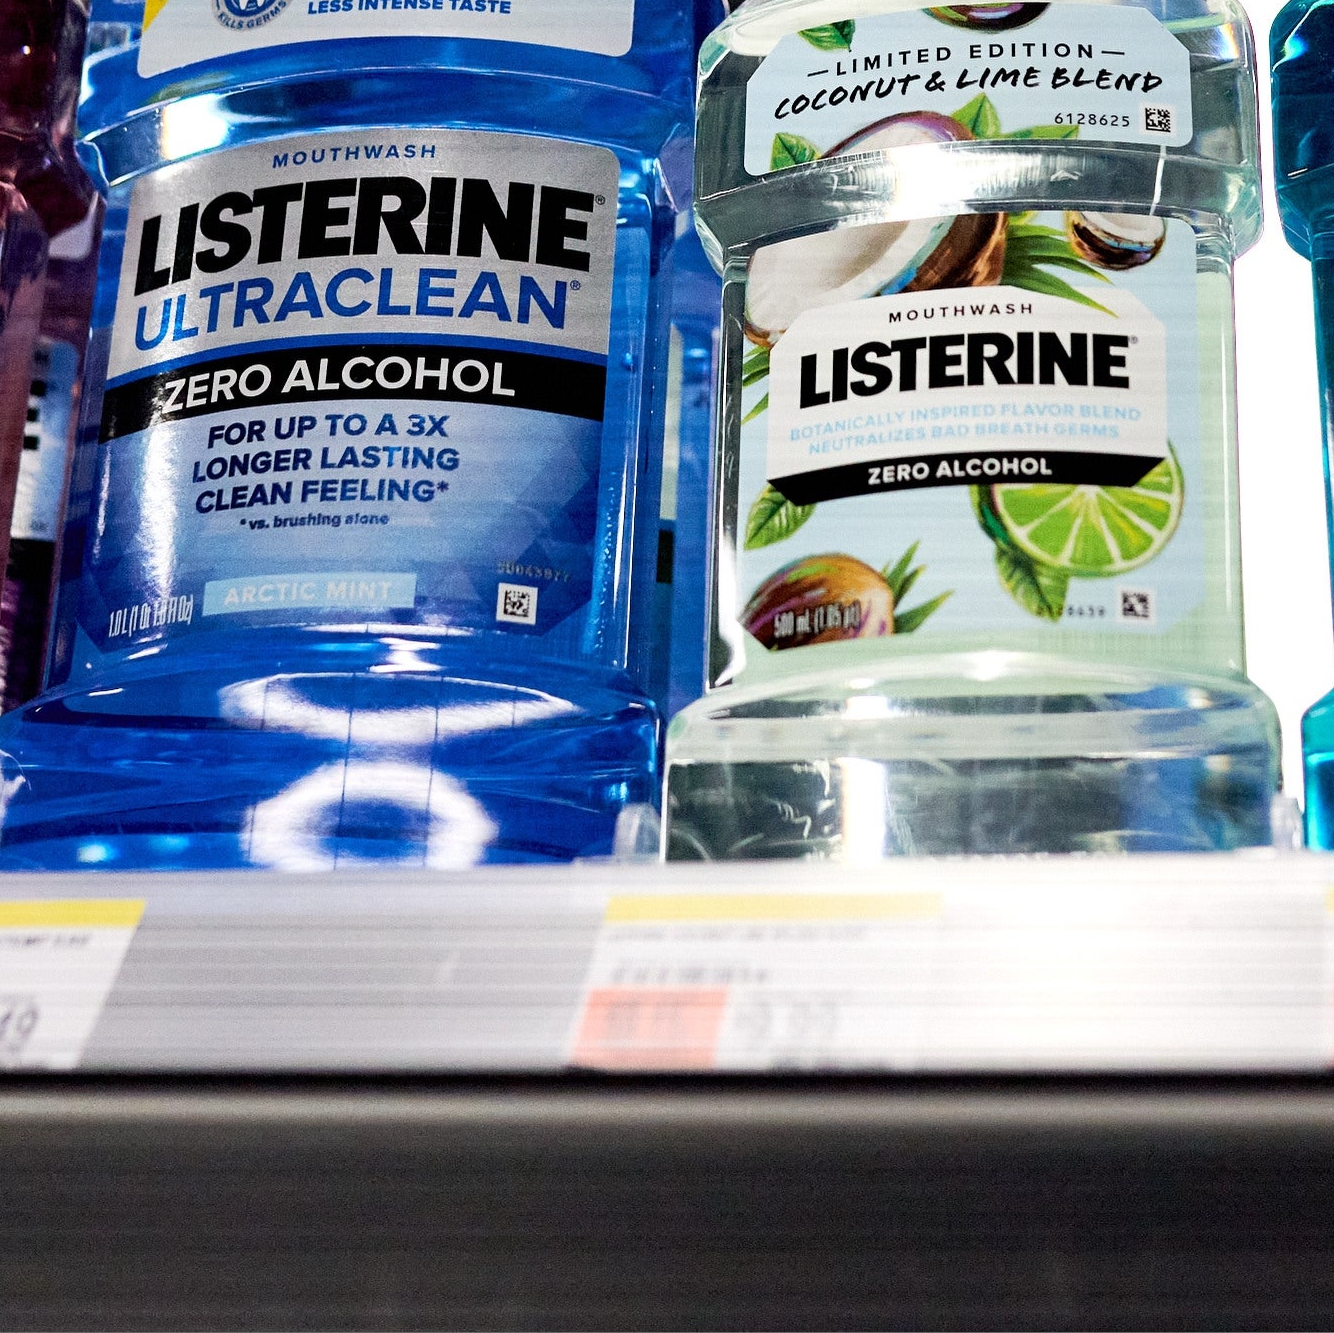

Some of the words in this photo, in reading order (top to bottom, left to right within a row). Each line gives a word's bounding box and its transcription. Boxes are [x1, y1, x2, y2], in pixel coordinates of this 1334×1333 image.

[218, 11, 243, 29] KILLS
[246, 0, 287, 28] GERMS
[836, 47, 952, 75] LIMITED
[970, 43, 1093, 59] EDITION
[774, 75, 922, 120] COCONUT
[925, 71, 946, 91] &
[956, 68, 1039, 89] LIME
[1051, 68, 1164, 93] BLEND
[1054, 113, 1130, 127] 6128625
[273, 144, 436, 169] MOUTHWASH
[889, 304, 1033, 323] MOUTHWASH
[161, 363, 271, 415] ZERO
[281, 355, 516, 397] ALCOHOL
[207, 421, 265, 449] FOR
[273, 416, 317, 440] UP
[323, 414, 368, 437] TO
[374, 414, 397, 436] A
[406, 414, 450, 438] 3X
[789, 408, 906, 442] BOTANICALLY
[910, 404, 995, 422] INSPIRED
[1000, 403, 1074, 418] FLAVOR
[1079, 404, 1141, 422] BLEND
[808, 426, 926, 455] NEUTRALIZES
[930, 424, 971, 439] BAD
[975, 423, 1048, 436] BREATH
[1053, 424, 1119, 438] GERMS
[192, 448, 313, 483] LONGER
[319, 446, 459, 471] LASTING
[867, 463, 929, 485] ZERO
[937, 458, 1053, 477] ALCOHOL
[194, 483, 291, 514] CLEAN
[273, 512, 341, 528] brushing
[345, 513, 389, 526] alone
[224, 581, 315, 606] ARCTIC
[325, 580, 394, 600] MINT
